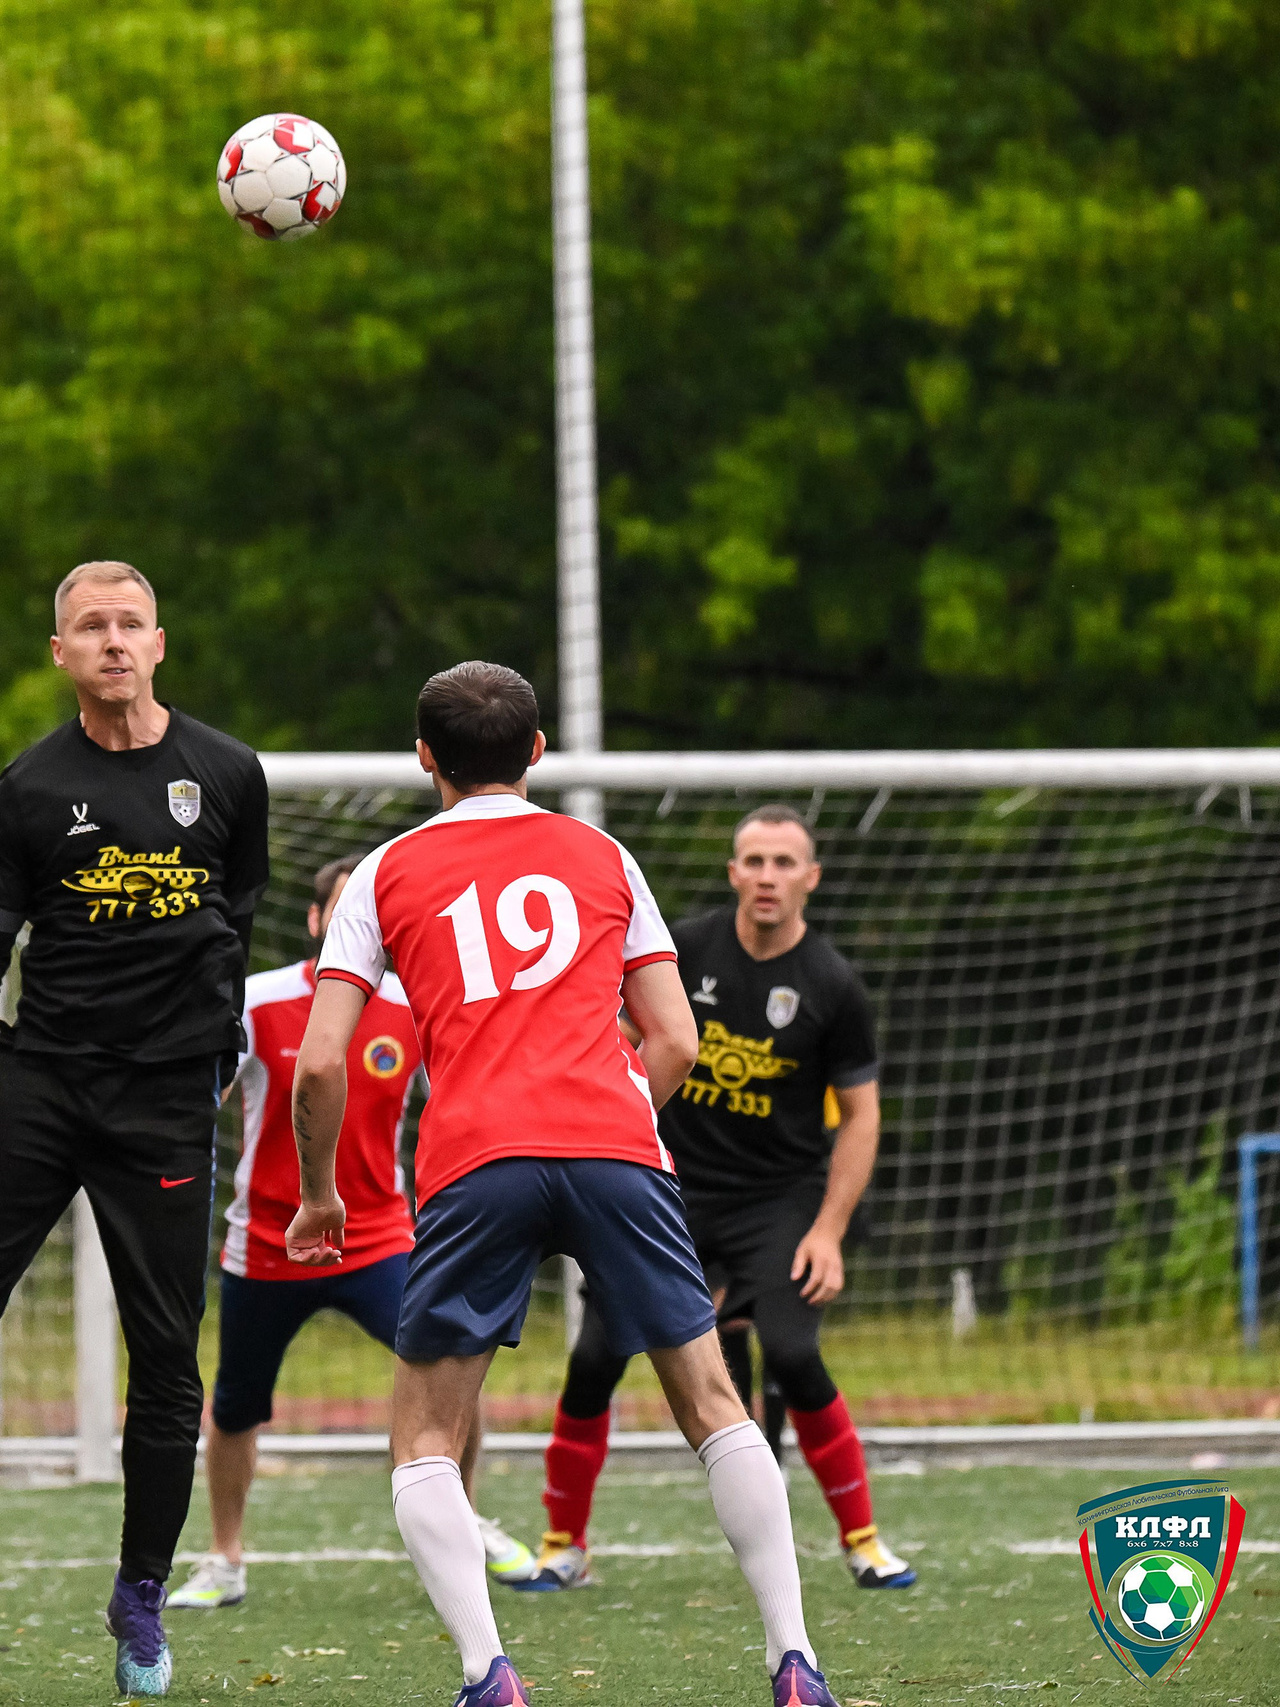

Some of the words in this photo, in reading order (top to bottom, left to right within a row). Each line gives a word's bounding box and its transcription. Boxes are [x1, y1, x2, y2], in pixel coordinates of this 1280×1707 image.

[98, 845, 182, 868] Brand
[86, 898, 138, 924] 777
[149, 891, 201, 919] 333
[435, 873, 581, 1006] 19
[726, 1089, 772, 1119] 333
